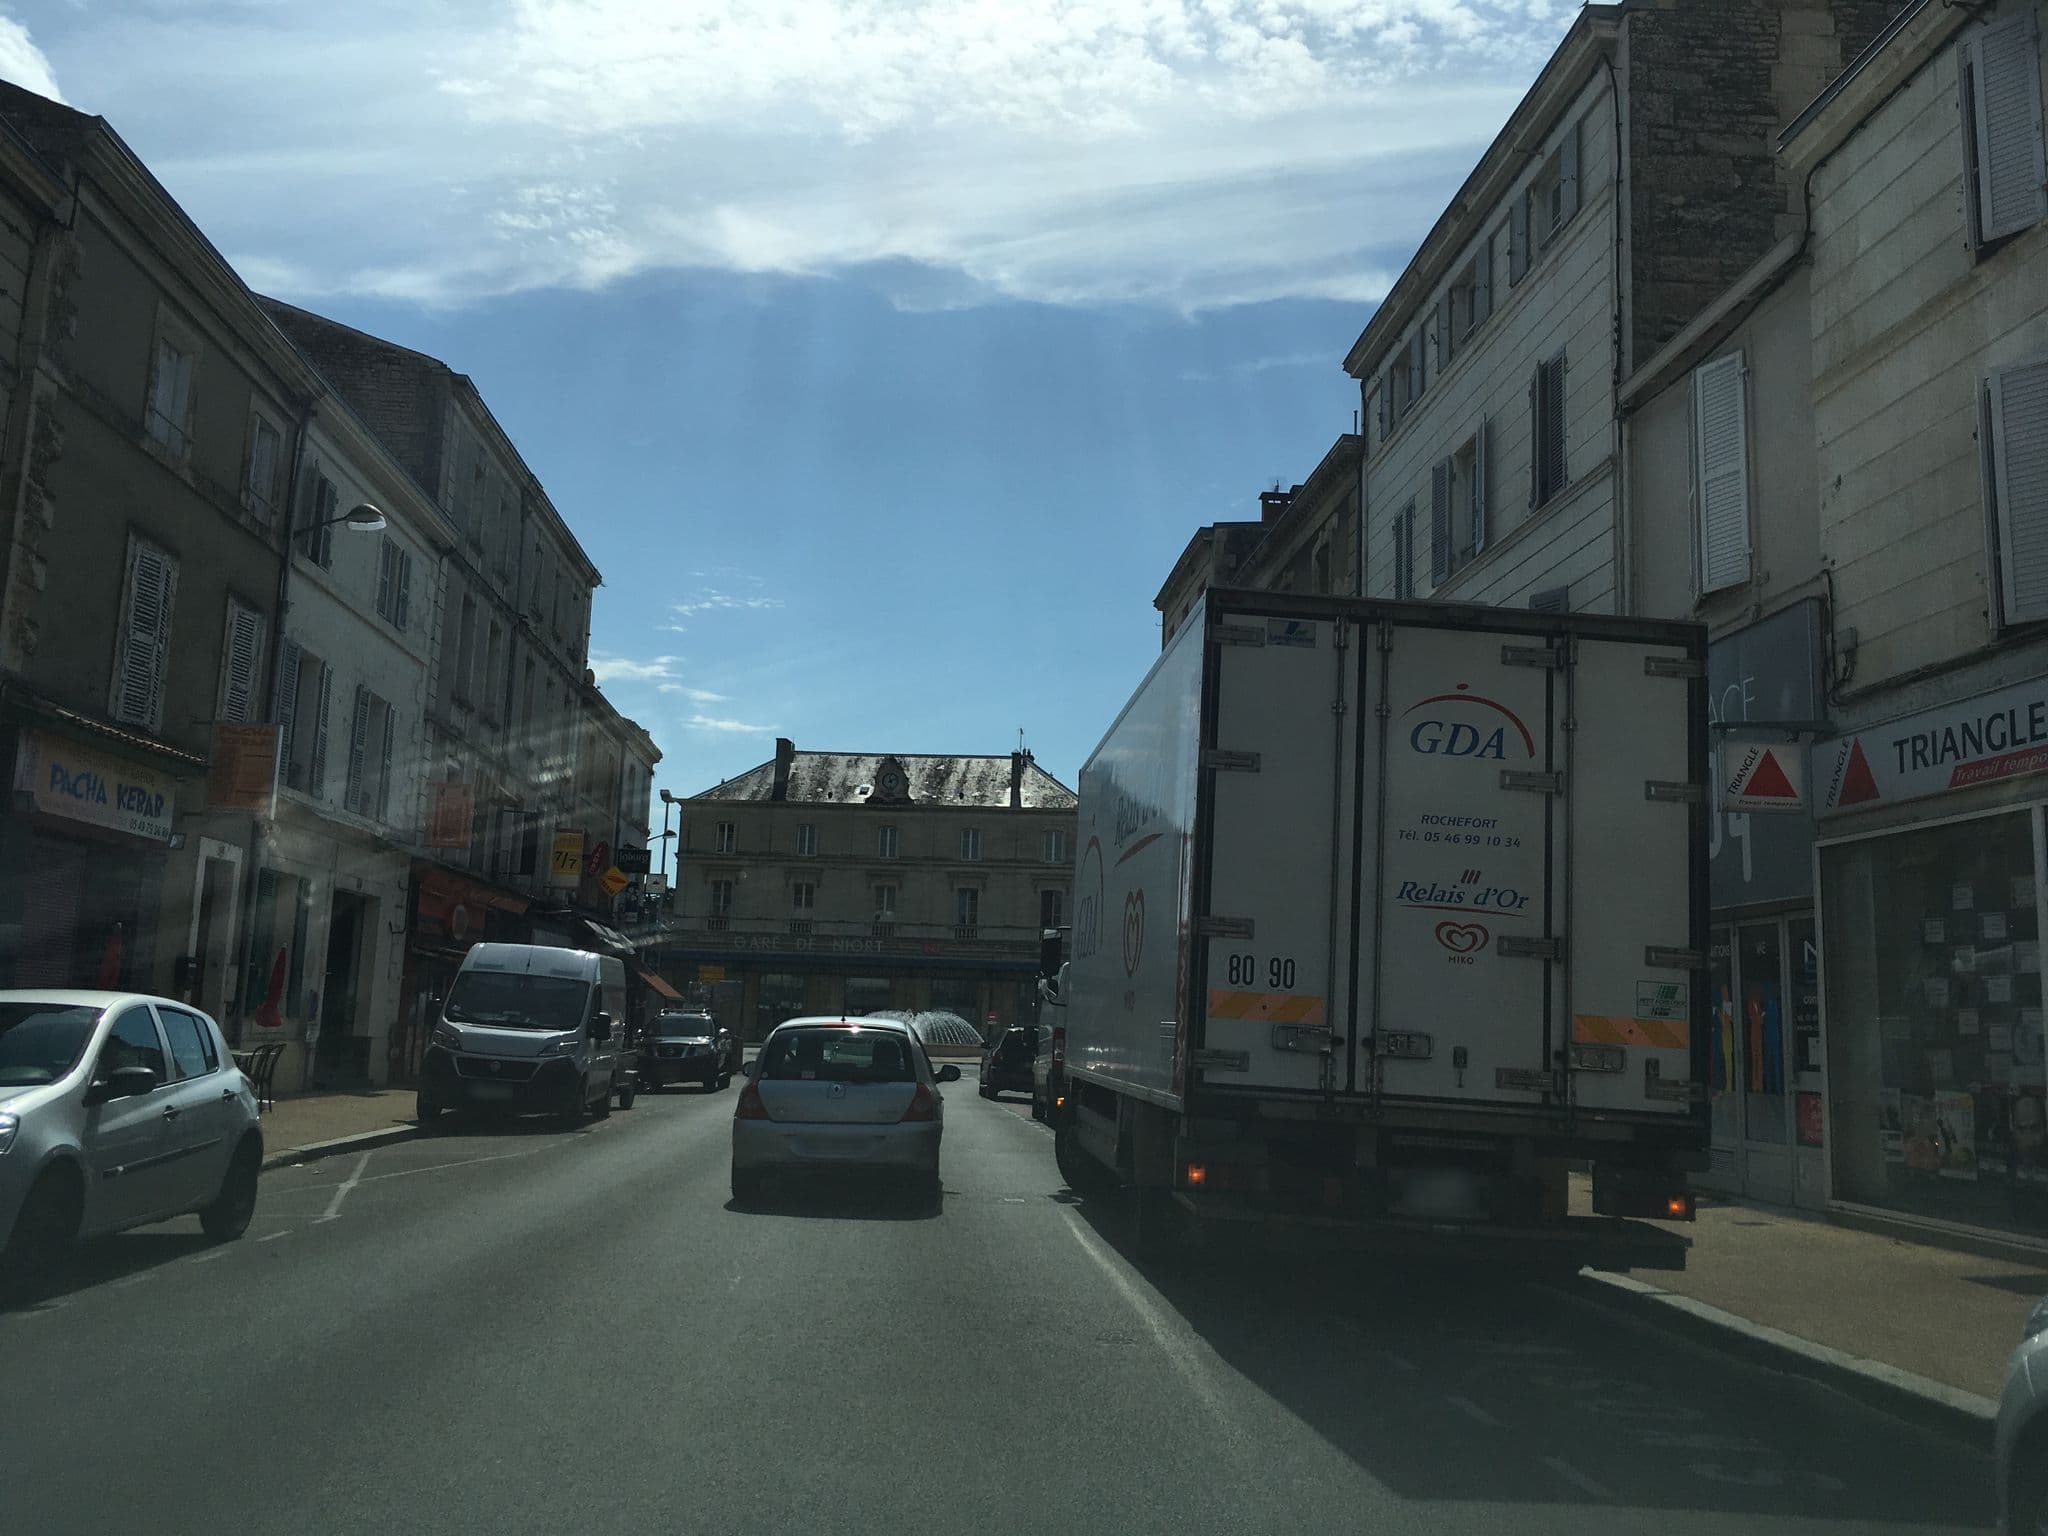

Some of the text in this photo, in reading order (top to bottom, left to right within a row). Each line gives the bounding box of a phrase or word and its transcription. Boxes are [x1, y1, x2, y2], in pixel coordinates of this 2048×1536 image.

[1410, 721, 1506, 760] GDA
[1893, 702, 2048, 774] TRIANGLE
[50, 761, 107, 805] PACHA
[1727, 747, 1760, 795] TRIANGLE
[1825, 736, 1850, 809] TRIANGLE
[1955, 761, 2000, 782] Travail
[1421, 814, 1498, 829] ROCHEFORT
[1424, 831, 1440, 842] 05
[1444, 833, 1460, 844] 46
[1464, 834, 1480, 845] 99
[1486, 836, 1501, 847] 10
[1505, 837, 1521, 848] 34
[554, 851, 578, 869] 7/7
[1396, 881, 1529, 909] Relais d'Or
[734, 936, 884, 953] GARE DE NIORT
[1228, 954, 1296, 989] 80 90
[1448, 956, 1474, 965] MIKO
